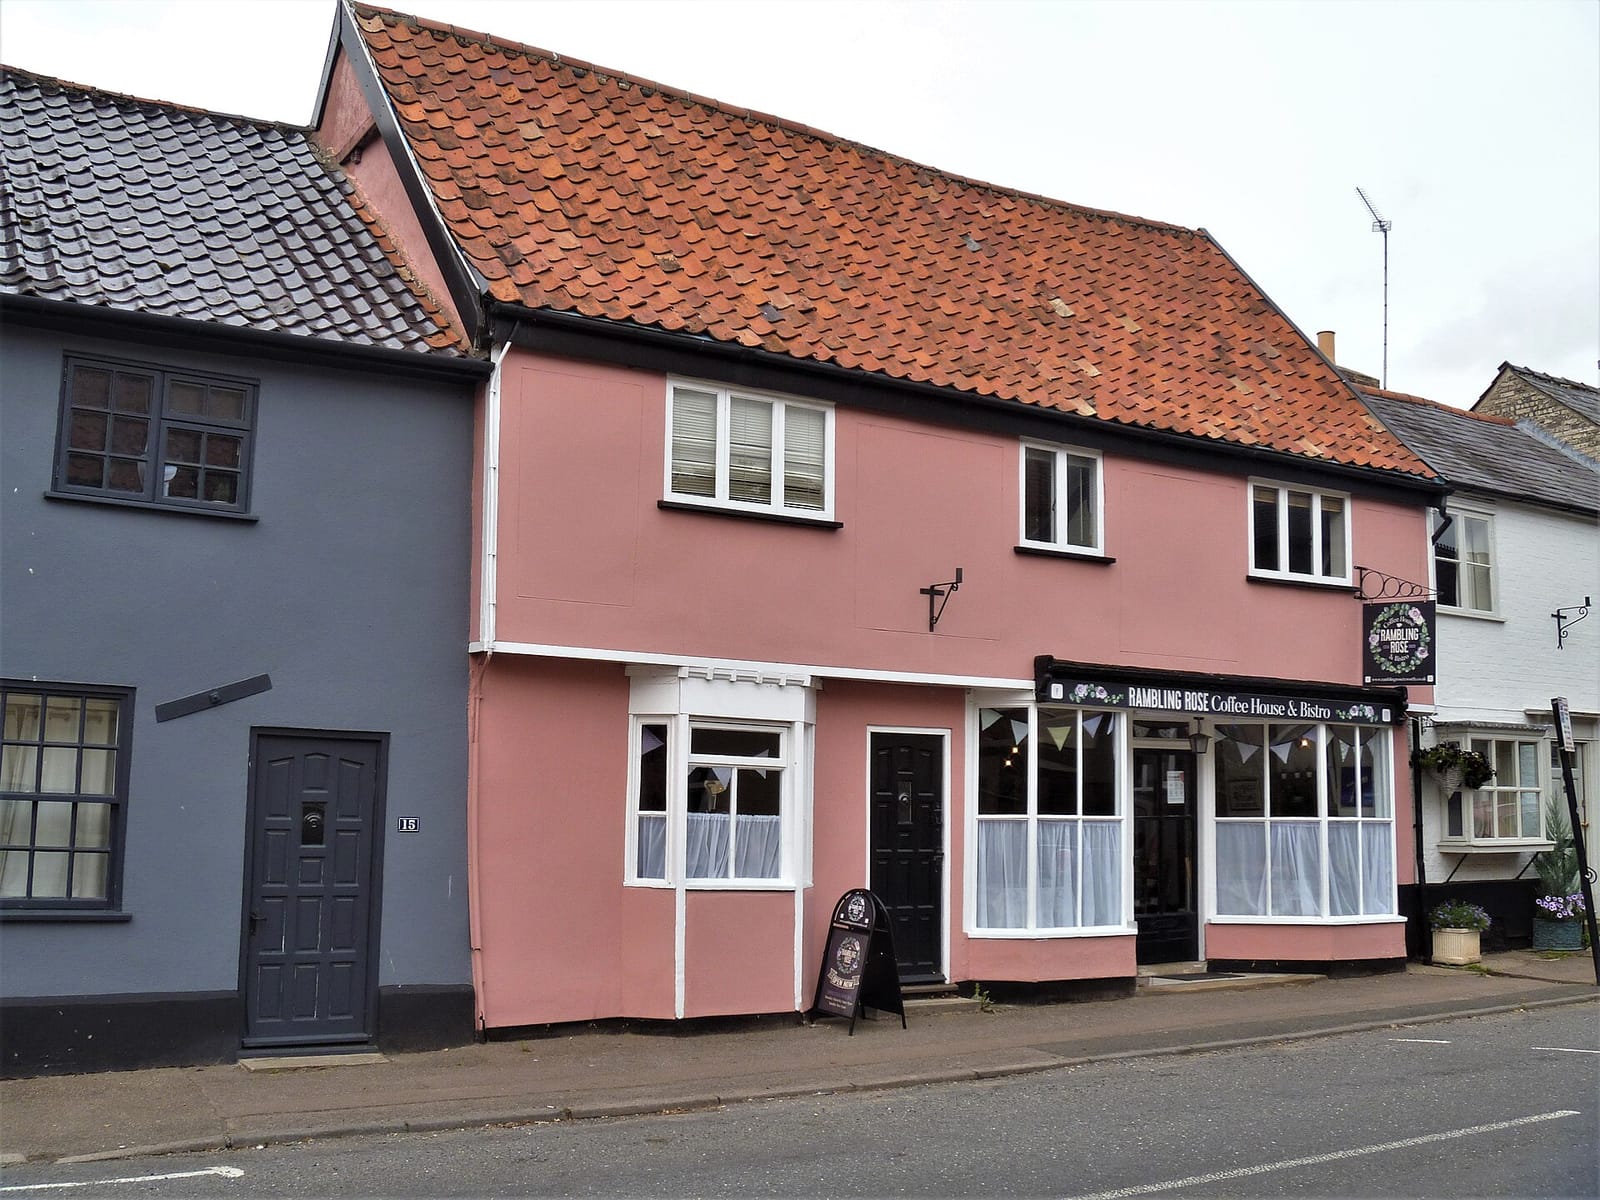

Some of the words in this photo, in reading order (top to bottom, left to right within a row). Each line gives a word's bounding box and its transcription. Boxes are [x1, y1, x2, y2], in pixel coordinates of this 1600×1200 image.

[1380, 628, 1419, 641] RAMBLING
[1390, 641, 1409, 654] ROSE
[1128, 686, 1182, 710] RAMBLING
[1184, 691, 1210, 712] ROSE
[1211, 694, 1249, 713] Coffee
[1251, 697, 1285, 716] House
[1287, 699, 1298, 717] &
[1300, 701, 1331, 719] Bistro
[402, 819, 416, 830] 15
